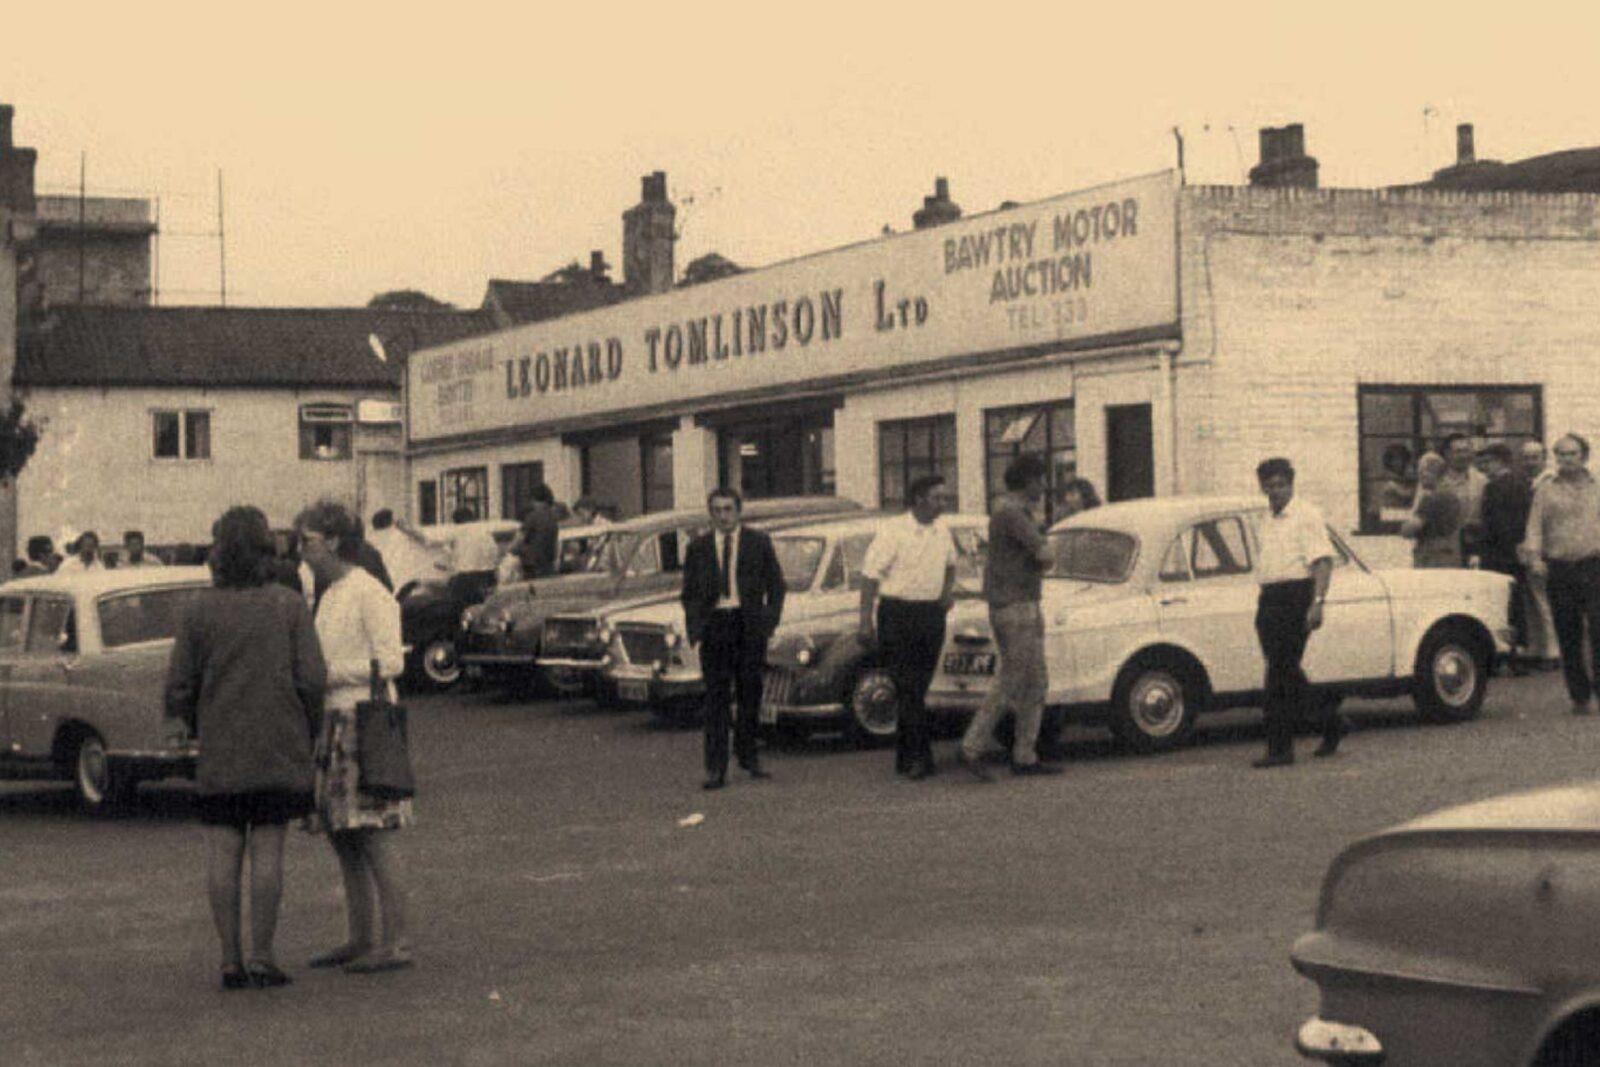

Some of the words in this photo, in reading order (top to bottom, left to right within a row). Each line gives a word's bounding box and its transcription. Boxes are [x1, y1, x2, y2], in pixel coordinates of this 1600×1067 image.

[943, 219, 1037, 275] BAWTRY
[1052, 198, 1138, 251] MOTOR
[989, 253, 1092, 304] AUCTION
[505, 337, 623, 399] LEONARD
[645, 288, 842, 373] TOMLINSON
